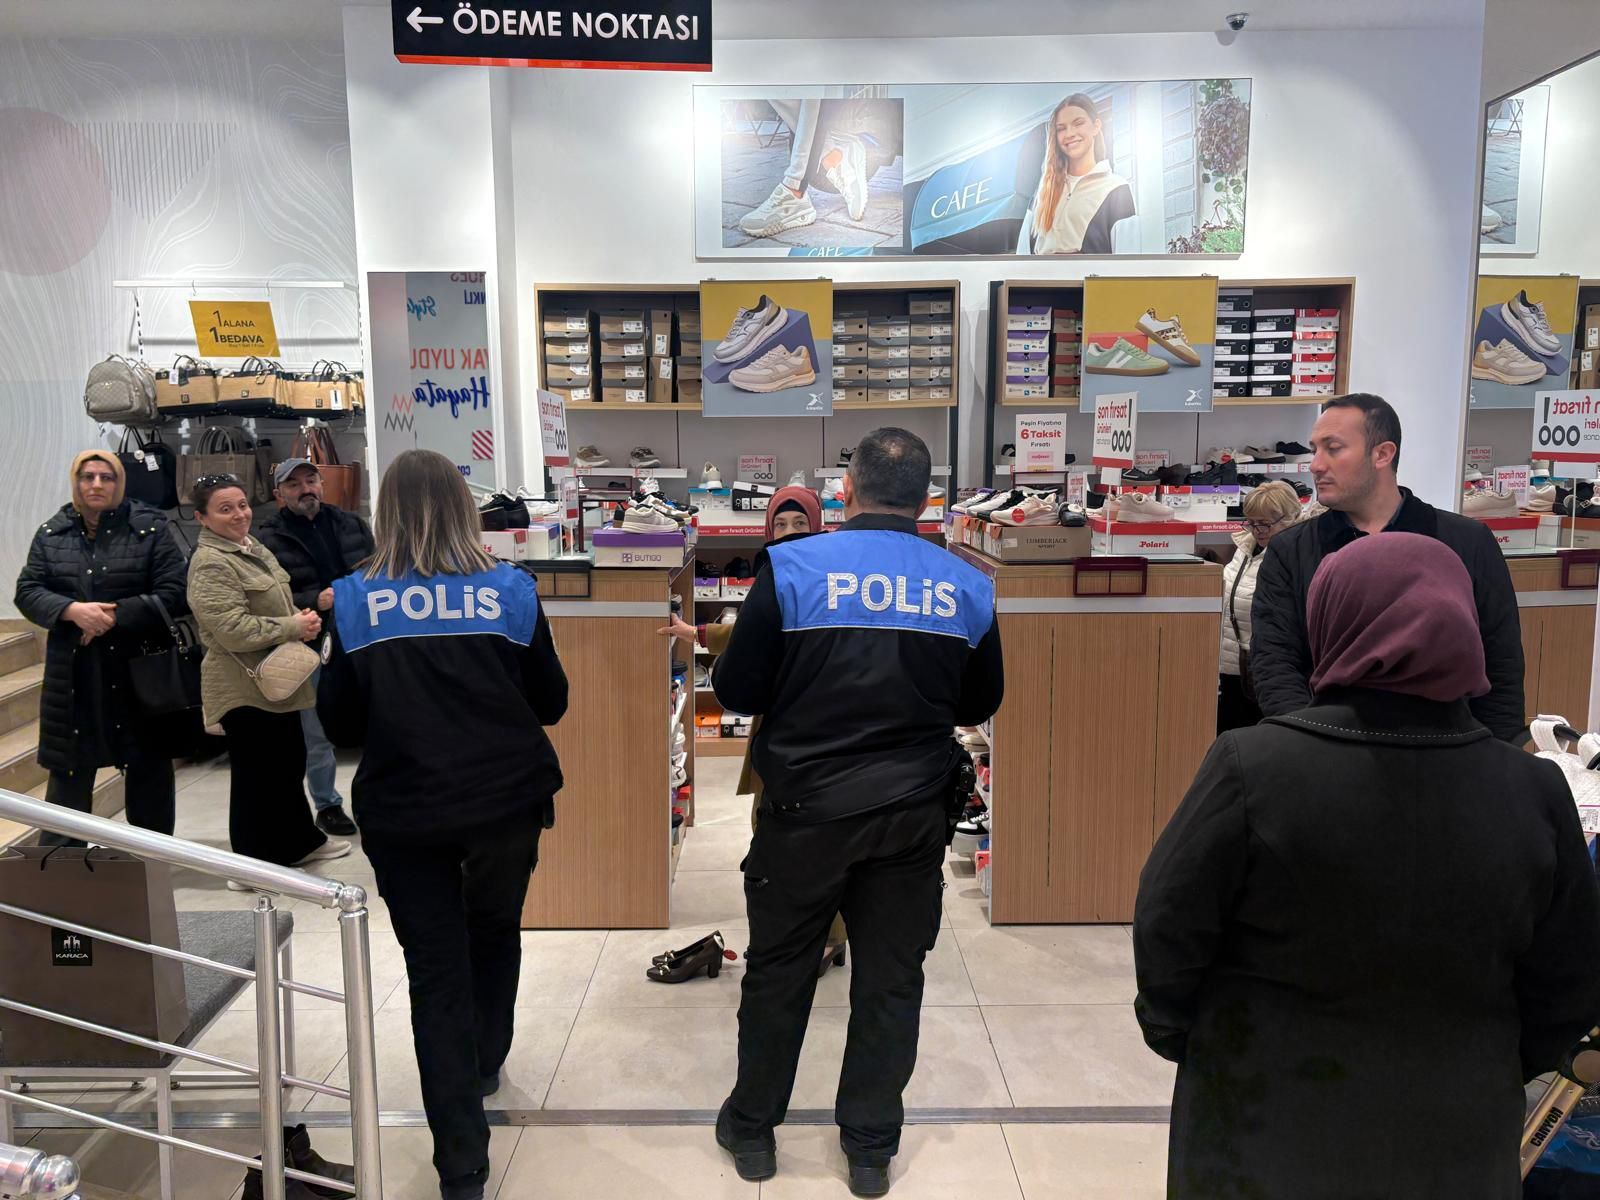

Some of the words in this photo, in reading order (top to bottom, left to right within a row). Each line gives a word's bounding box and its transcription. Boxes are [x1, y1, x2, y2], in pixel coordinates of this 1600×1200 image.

[452, 2, 562, 38] ÖDEME
[572, 12, 699, 41] NOKTASI
[930, 176, 993, 219] CAFE
[212, 310, 222, 327] 1
[223, 319, 256, 328] ALANA
[209, 326, 219, 343] 1
[220, 334, 265, 344] BEDAVA
[1020, 428, 1030, 440] 6
[1030, 430, 1062, 439] Taksit
[1138, 540, 1169, 548] Polaris
[1530, 1106, 1564, 1147] CANYON
